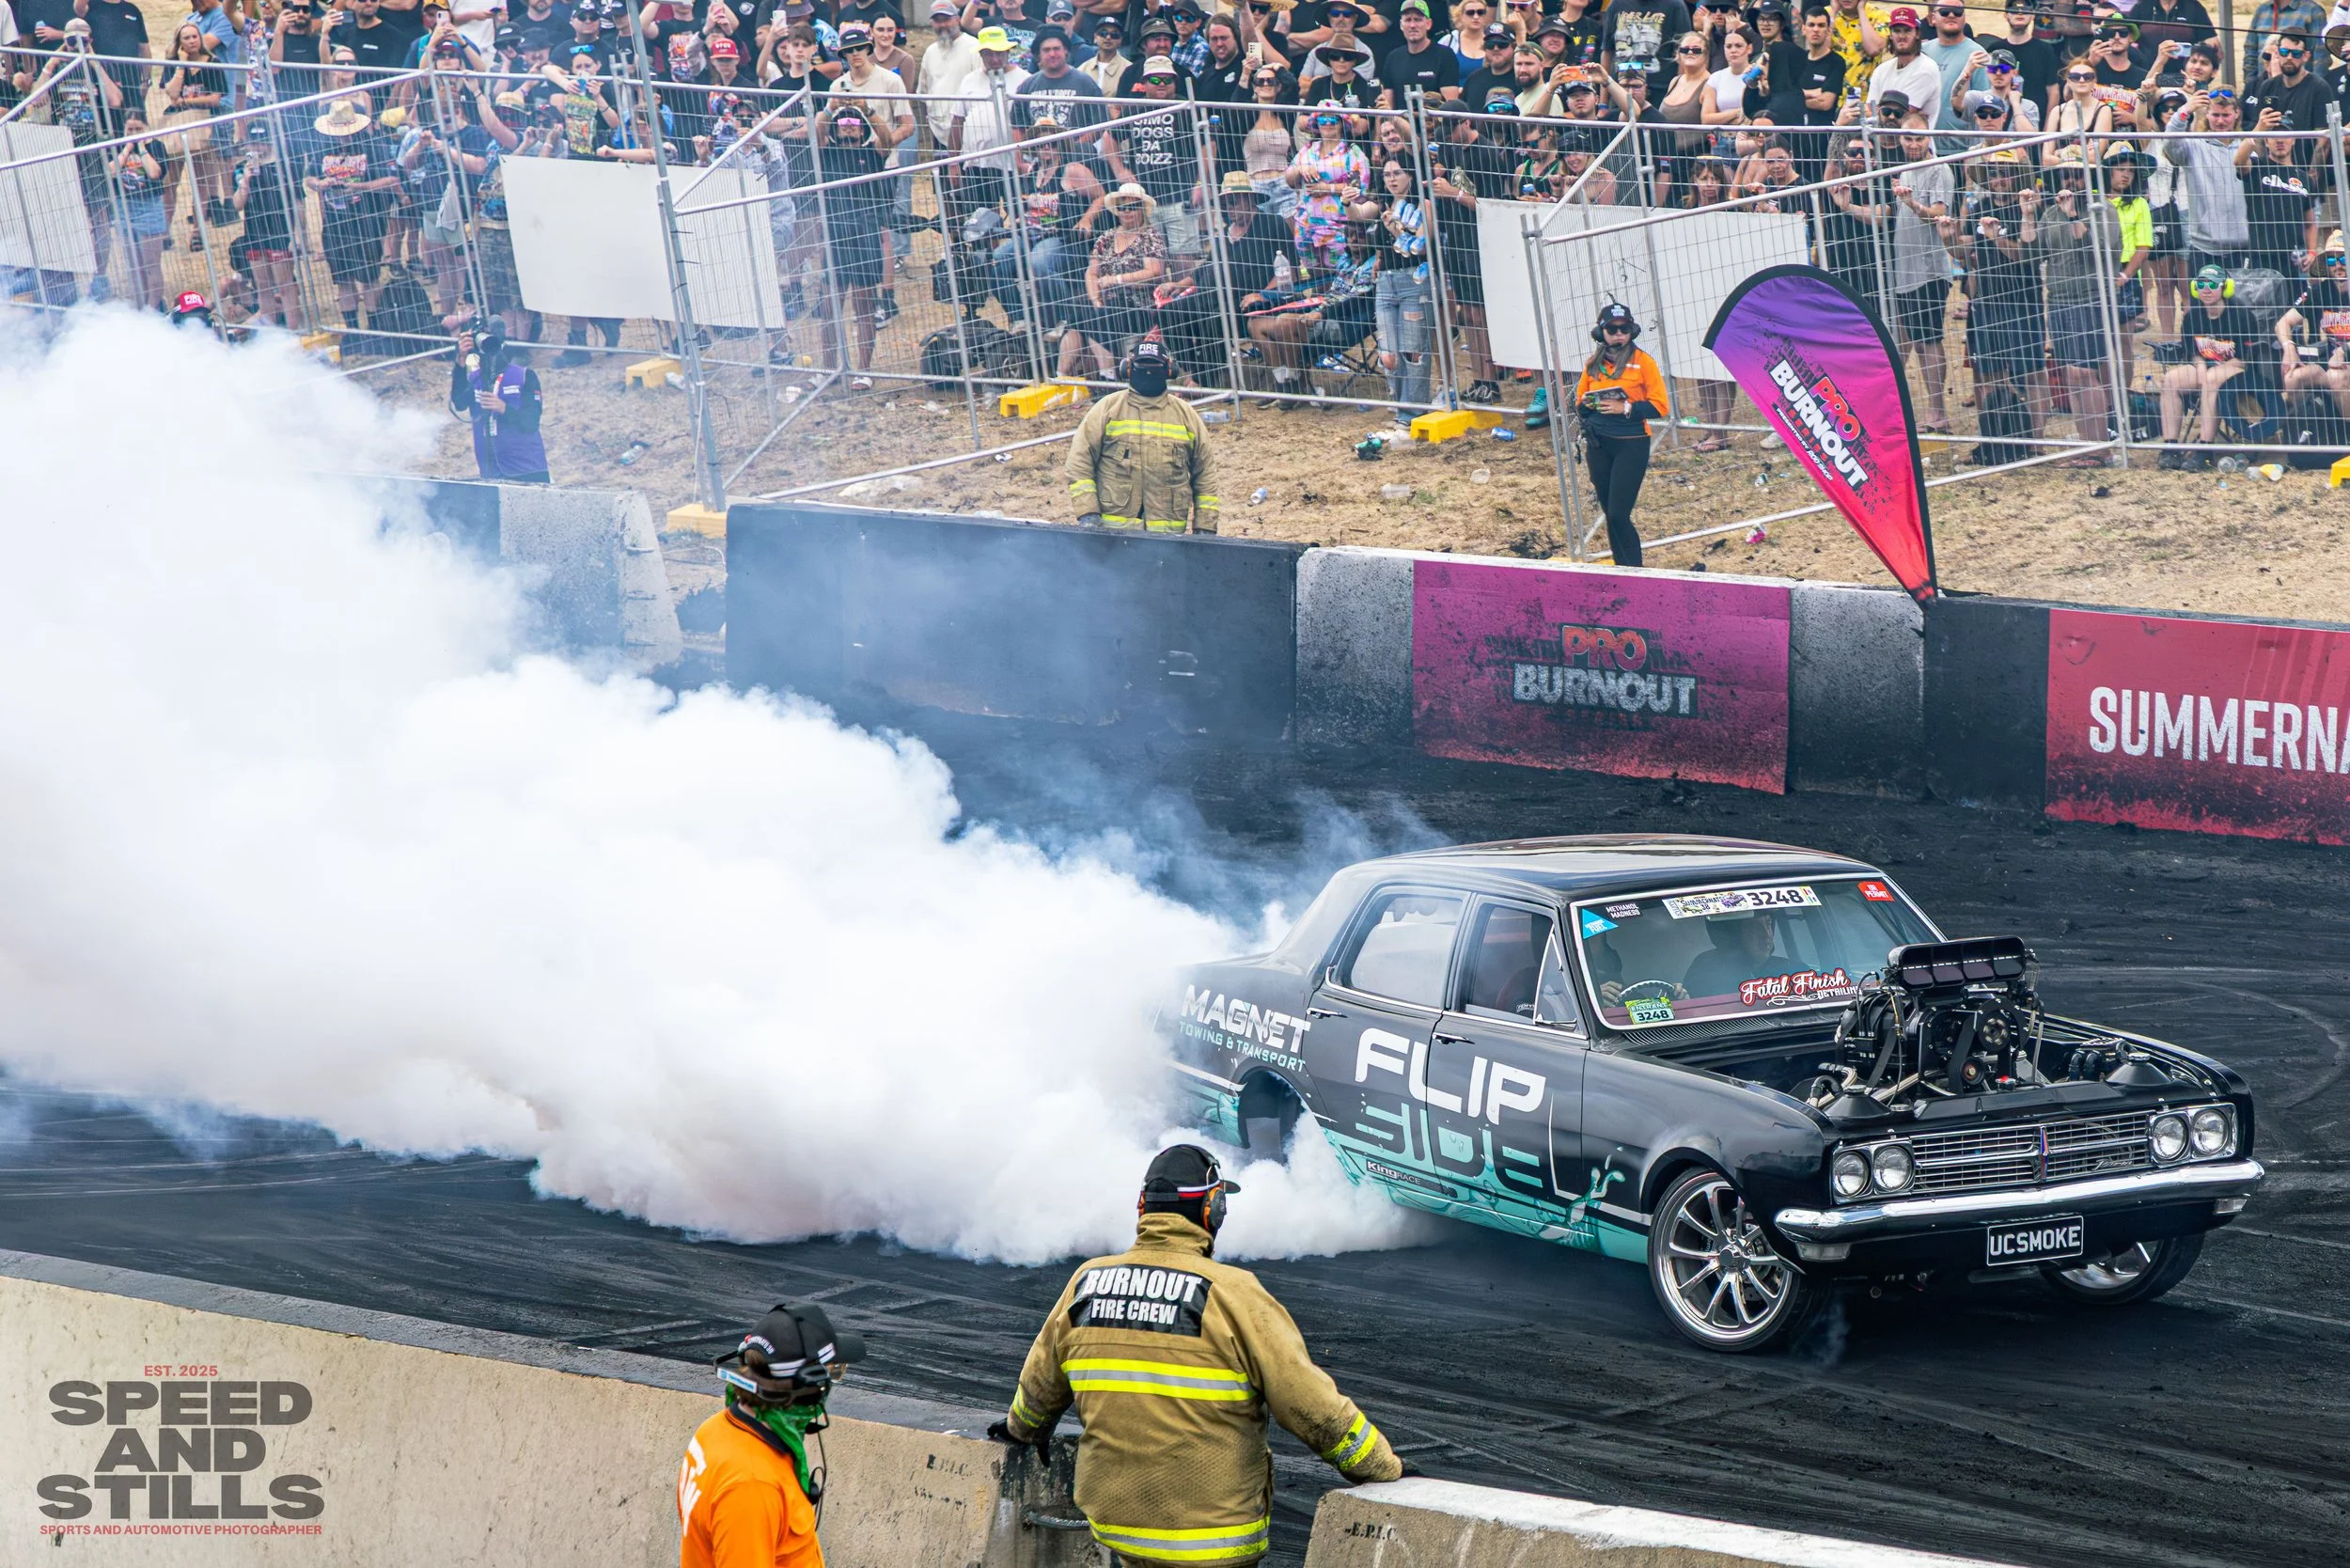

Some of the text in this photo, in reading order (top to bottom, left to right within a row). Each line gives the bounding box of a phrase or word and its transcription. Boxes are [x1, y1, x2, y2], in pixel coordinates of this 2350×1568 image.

[1770, 359, 1869, 487] BURNOUT
[1777, 407, 1803, 442] PRESENTED
[1808, 377, 1860, 442] PRO
[1788, 409, 1828, 462] SERIES
[1561, 624, 1647, 671] PRO
[1513, 663, 1696, 714] BURNOUT
[1606, 902, 1639, 913] METHANOL
[1747, 889, 1805, 906] 3248
[1864, 889, 1888, 899] PERMIT
[1609, 909, 1641, 919] MADNESS
[1741, 967, 1848, 1004] Fatal Finish
[1181, 984, 1311, 1054] MAGNET
[1630, 1002, 1667, 1011] ENTRANT
[1637, 1010, 1669, 1022] 3248
[1179, 1021, 1306, 1073] TOWING & TRANSPORT
[1355, 1027, 1546, 1125] FLIP
[1354, 1103, 1545, 1198] SIDE
[1989, 1226, 2081, 1256] UCSMOKE
[1082, 1267, 1203, 1303] BURNOUT
[1090, 1298, 1178, 1325] FIRE CREW
